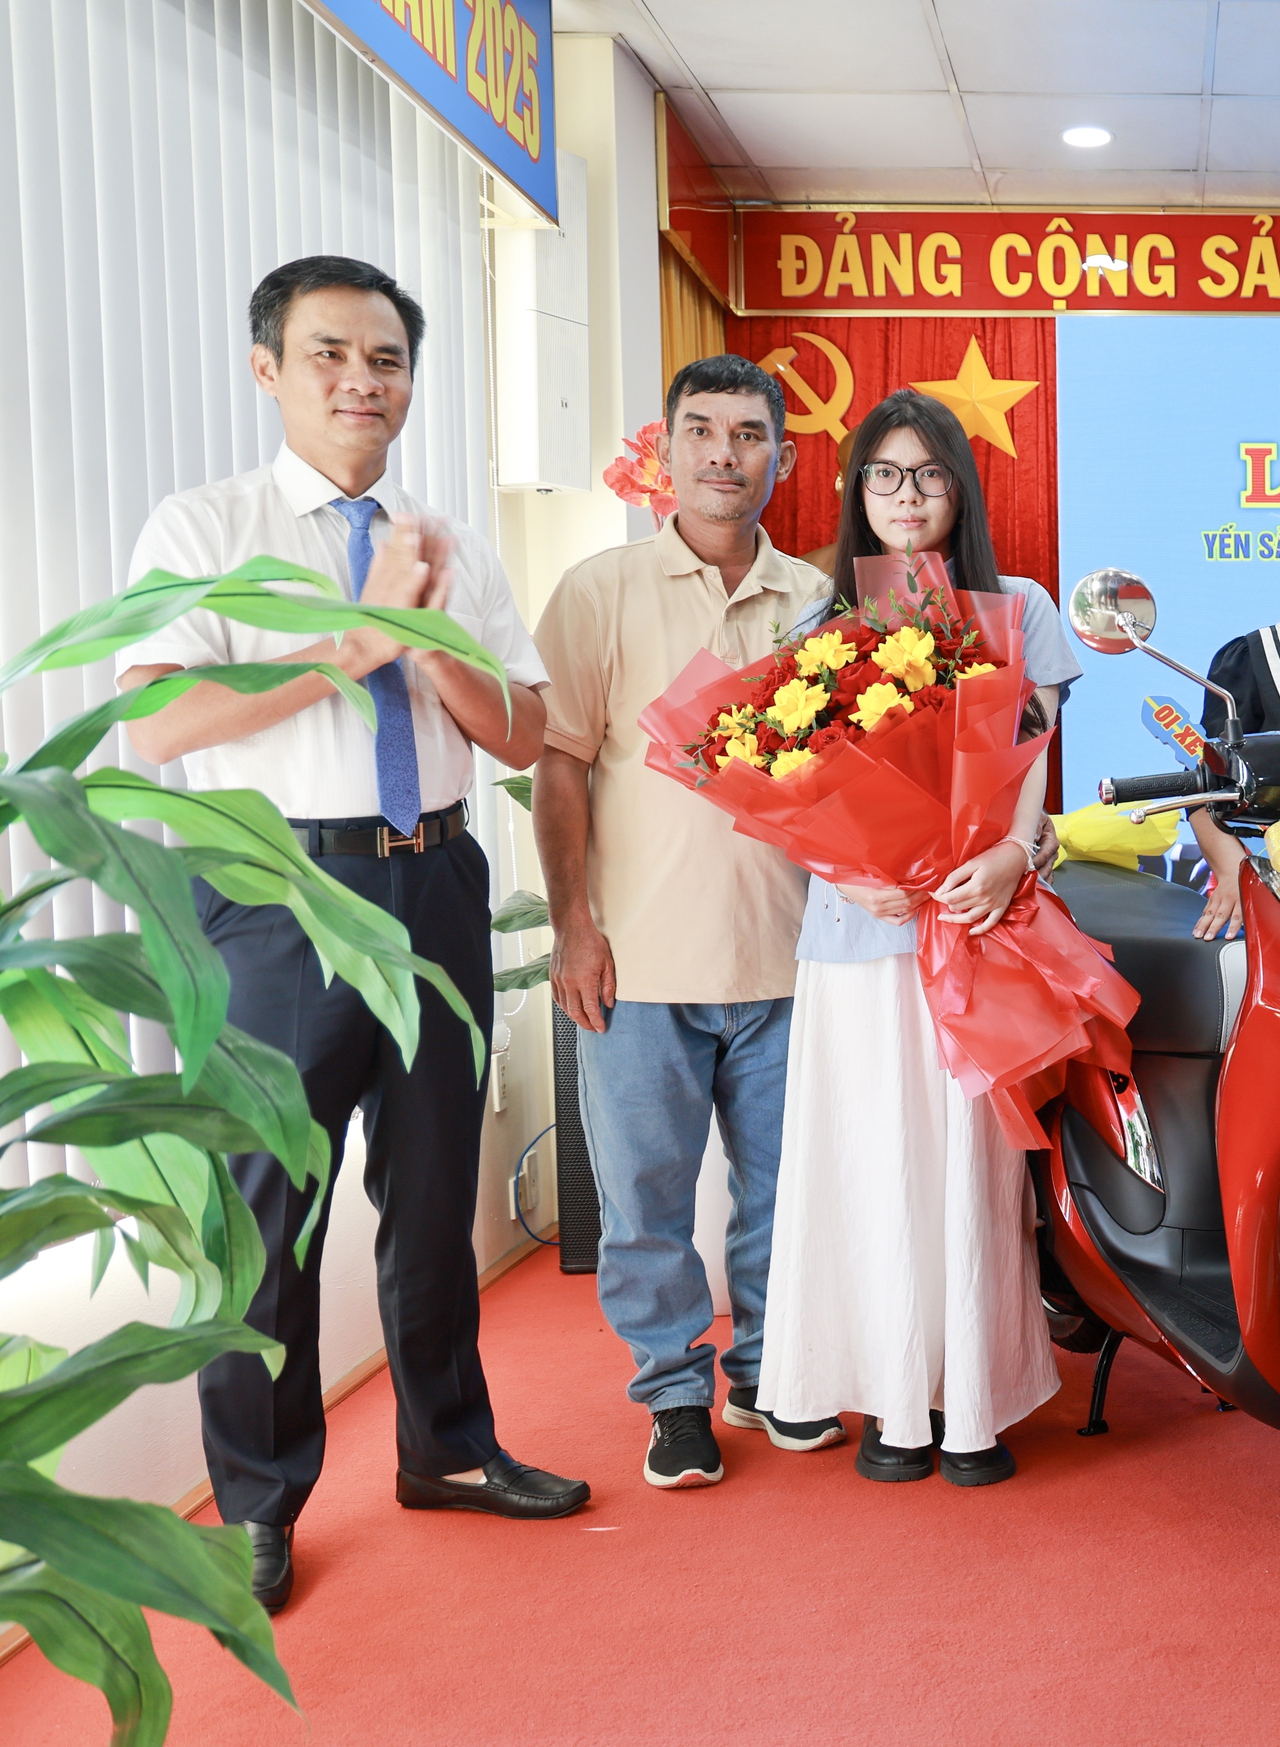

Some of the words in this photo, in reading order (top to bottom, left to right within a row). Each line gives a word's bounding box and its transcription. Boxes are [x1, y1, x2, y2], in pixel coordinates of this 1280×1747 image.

[777, 211, 962, 297] ĐẢNG
[989, 217, 1176, 310] CỘNG
[1203, 523, 1251, 560] YẾN
